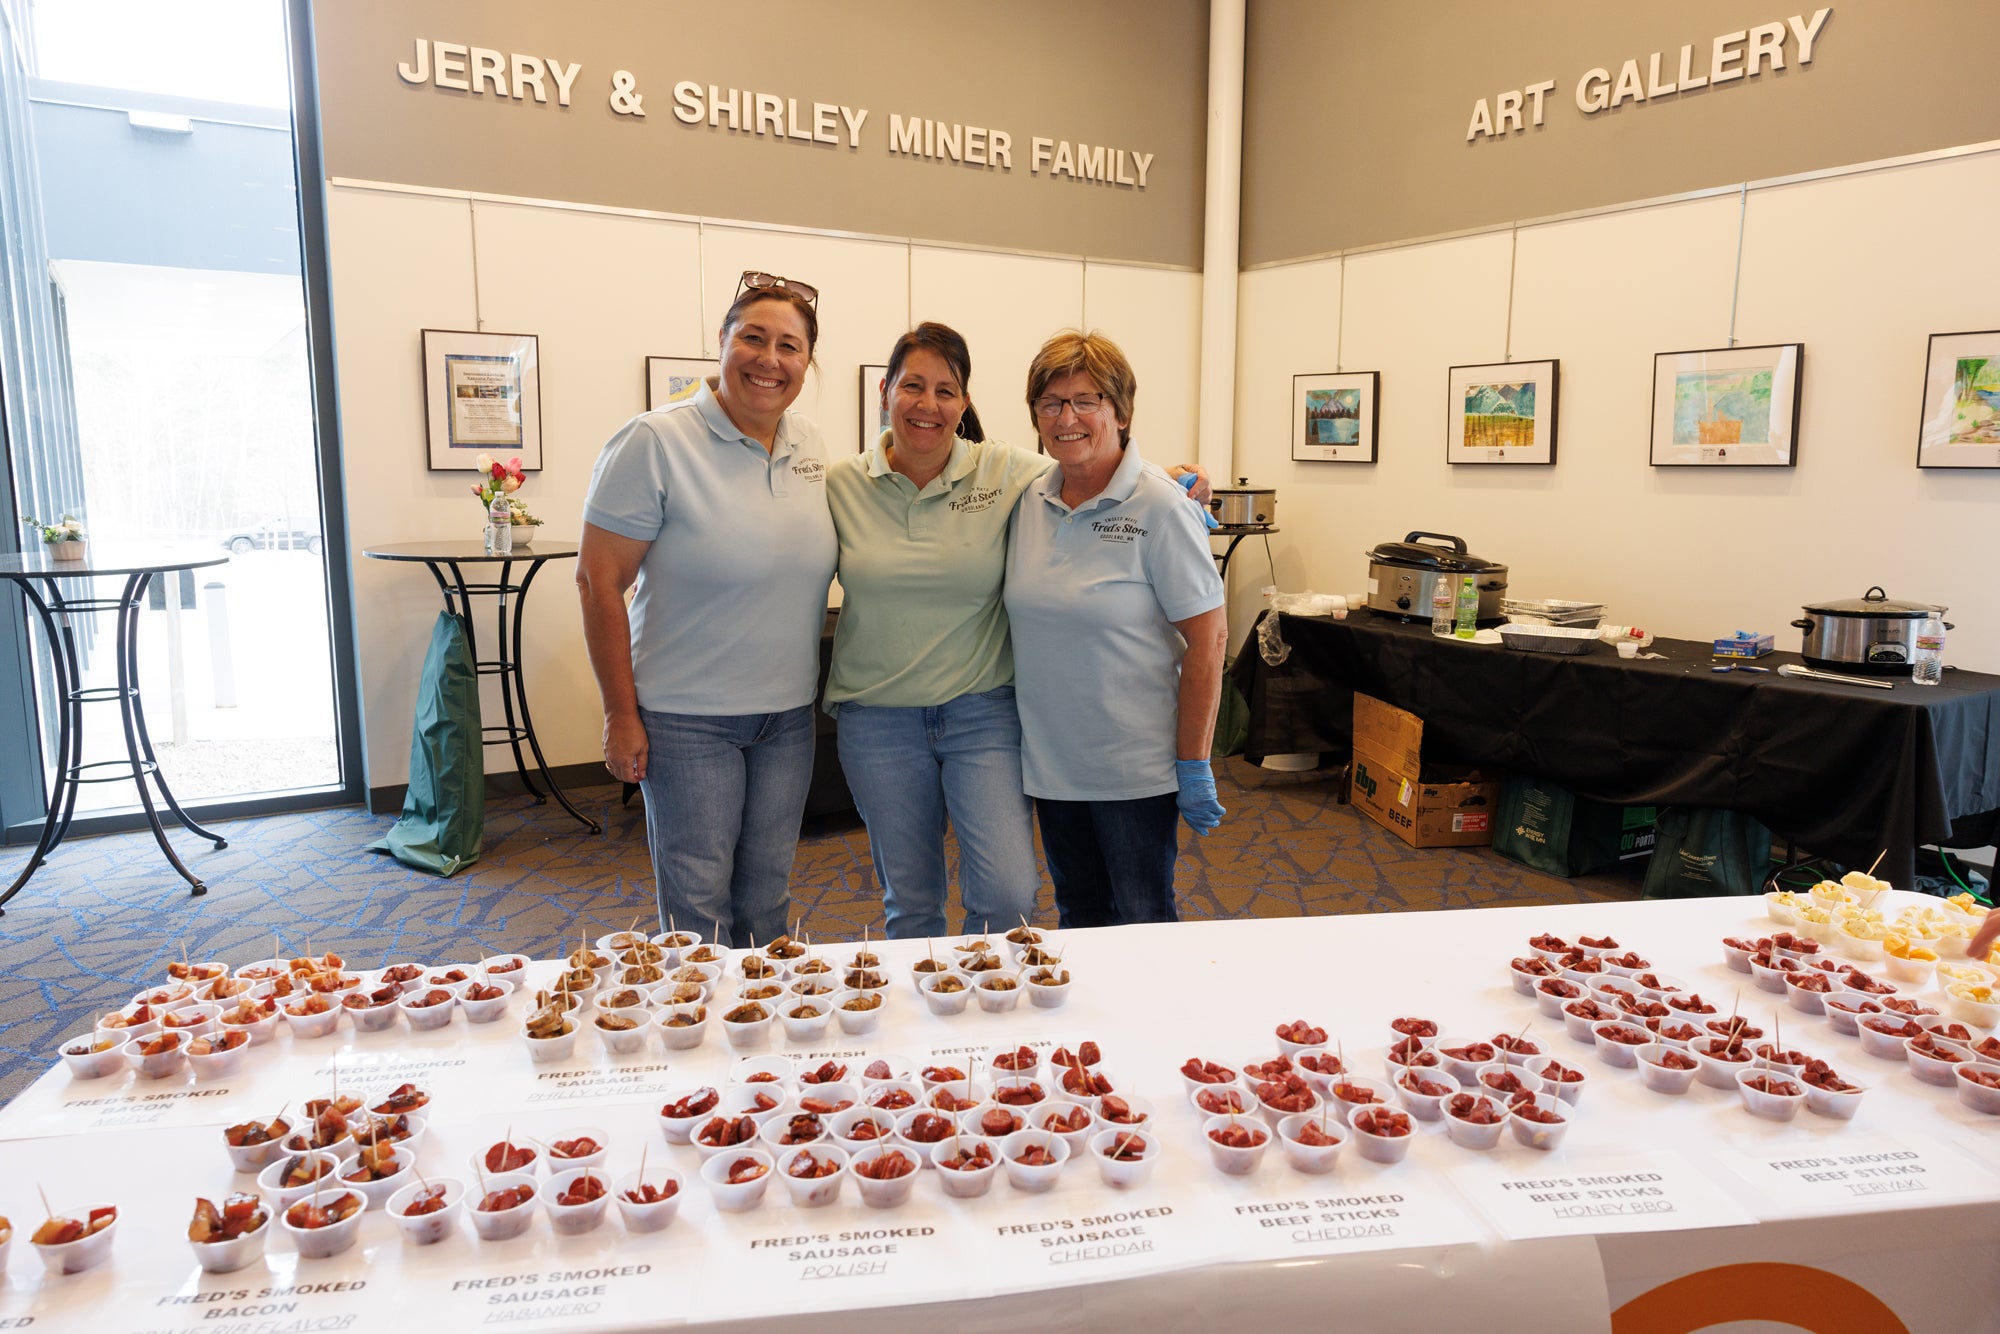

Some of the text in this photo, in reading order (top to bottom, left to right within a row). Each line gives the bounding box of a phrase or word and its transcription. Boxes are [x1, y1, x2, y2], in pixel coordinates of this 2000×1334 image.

[1466, 7, 1834, 141] ART GALLERY
[398, 38, 1155, 188] JERRY & SHIRLEY MINER FAMILY
[949, 488, 1003, 511] Fred's Store
[1091, 521, 1148, 537] Fred's Store
[1355, 762, 1377, 799] ibp
[1388, 808, 1413, 830] BEEF
[931, 1046, 990, 1056] FRED'S
[314, 1060, 467, 1076] FRED'S SMOKED
[339, 1071, 430, 1085] SAUSAGE
[537, 1064, 669, 1080] FRED'S FRESH
[556, 1075, 646, 1088] SAUSAGE
[63, 1088, 230, 1108] FRED'S SMOKED
[527, 1083, 672, 1102] PHILLY CHEESE
[100, 1102, 175, 1115] BACON
[1769, 1151, 1920, 1171] FRED'S SMOKED
[1502, 1173, 1663, 1191] FRED'S SMOKED
[1800, 1164, 1927, 1183] BEEF STICKS
[1529, 1186, 1664, 1203] BEEF STICKS
[1844, 1178, 1928, 1196] TERIYAKI
[1234, 1194, 1405, 1216] FRED'S SMOKED
[1552, 1200, 1677, 1218] HONEY BBQ
[997, 1206, 1174, 1236] FRED'S SMOKED
[1259, 1208, 1400, 1228] BEEF STICKS
[750, 1226, 935, 1249] FRED'S SMOKED
[1040, 1225, 1146, 1248] SAUSAGE
[1291, 1223, 1394, 1243] CHEDDAR
[788, 1243, 899, 1261] SAUSAGE
[1048, 1239, 1154, 1265] CHEDDAR
[452, 1264, 652, 1291] FRED'S SMOKED
[799, 1260, 888, 1280] POLISH
[156, 1281, 367, 1306] FRED'S SMOKED
[487, 1284, 608, 1305] SAUSAGE
[203, 1302, 299, 1320] BACON
[482, 1301, 601, 1324] HABANERO
[253, 1314, 358, 1334] FLAVOR
